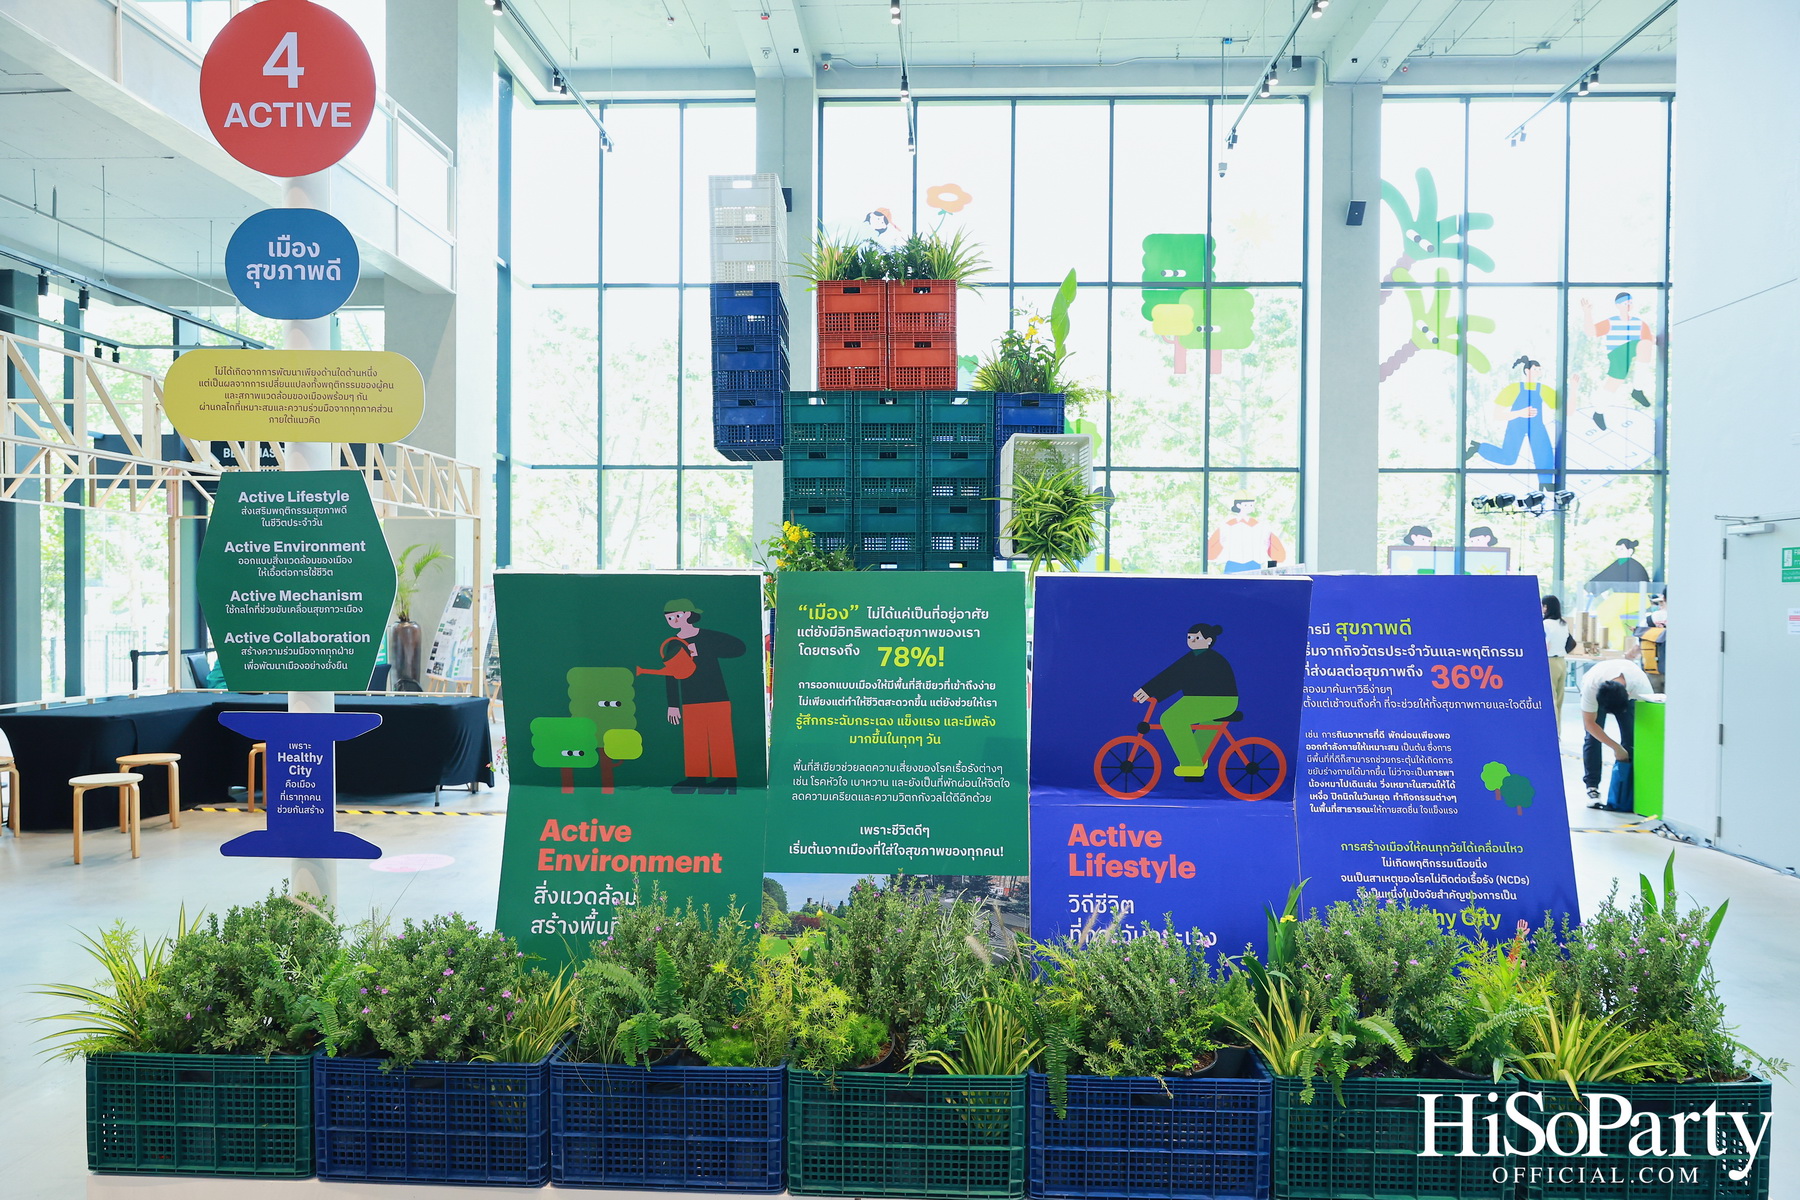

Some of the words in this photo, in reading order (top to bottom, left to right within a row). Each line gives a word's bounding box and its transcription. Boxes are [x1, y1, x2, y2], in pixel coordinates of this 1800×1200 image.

[262, 32, 304, 88] 4
[224, 102, 351, 128] ACTIVE
[268, 234, 320, 258] เมือง
[246, 260, 341, 289] สุขภาพดี
[269, 414, 320, 424] ภายใต้แนวคิด
[238, 491, 284, 503] Active
[288, 490, 350, 504] Lifestyle
[242, 505, 347, 517] ส่งเสริมพฤติกรรมสุขภาพดี
[261, 518, 323, 527] ในชีวิตประจำวัน
[224, 542, 270, 553] Active
[274, 540, 366, 552] Environment
[238, 554, 352, 565] ออกแบบสิ่งแวดล้อมของเมือง
[258, 566, 334, 577] ให้เอื้อต่อการใช้ชีวิต
[230, 590, 276, 602] Active
[280, 590, 362, 602] Mechanism
[226, 603, 363, 616] ใช้กลไกที่ช่วยขับเคลื่อนสุขภาวะเมือง
[867, 605, 989, 623] ไม่ได้แค่เป็นที่อยู่อาศัย
[798, 626, 980, 642] แต่ยังมีอิทธิพลต่อสุขภาพของเรา
[1336, 618, 1412, 641] สุขภาพดี
[224, 632, 270, 644] Active
[273, 631, 370, 643] Collaboration
[241, 646, 354, 659] สร้างความร่วมมือจากทุกฝ่าย
[799, 643, 860, 656] โดยตรงถึง
[878, 646, 944, 667] 78%!
[244, 660, 348, 670] เพื่อพัฒนาเมืองอย่างยั่งยืน
[798, 678, 996, 690] การออกแบบเมืองให้มีพื้นที่สีเขียวที่เข้าถึงง่าย
[1431, 665, 1503, 690] 36%
[798, 694, 927, 707] ไม่เพียงแต่ทำให้ชีวิตสะดวกขึ้น
[930, 696, 997, 708] แต่ยังช่วยให้เรา
[796, 713, 894, 729] รู้สึกกระฉับกระเฉง
[897, 714, 940, 728] แข็งแรง
[944, 714, 996, 727] และมีพลัง
[289, 742, 312, 750] เพราะ
[926, 734, 941, 745] วัน
[278, 752, 323, 765] Healthy
[289, 765, 312, 777] City
[793, 759, 1002, 774] พื้นที่สีเขียวช่วยลดความเสี่ยงของโรคเรื้อรังต่างๆ
[286, 779, 316, 788] คือเมือง
[792, 778, 808, 787] เช่น
[810, 777, 848, 788] โรคหัวใจ
[851, 779, 889, 788] เบาหวาน
[892, 776, 1010, 788] และยังเป็นที่พักผ่อนให้จิตใจ
[280, 790, 321, 804] ที่เราทุกคน
[792, 791, 992, 803] ลดความเครียดและความวิตกกังวลได้ดีอีกด้วย
[277, 804, 324, 814] ช่วยกันสร้าง
[540, 818, 632, 842] Active
[860, 824, 930, 838] เพราะชีวิตดีๆ
[1068, 823, 1162, 848] Active
[789, 840, 1004, 860] เริ่มต้นจากเมืองที่ใส่ใจสุขภาพของทุกคน!
[1341, 840, 1524, 856] การสร้างเมืองให้คนทุกวัยได้เคลื่อนไหว
[538, 848, 722, 873] Environment
[1382, 857, 1488, 870] ไม่เกิดพฤติกรรมเนือยนิ่ง
[1069, 853, 1196, 884] Lifestyle
[1496, 876, 1530, 886] (NCDs)
[534, 880, 636, 906] สิ่งแวดล้อม
